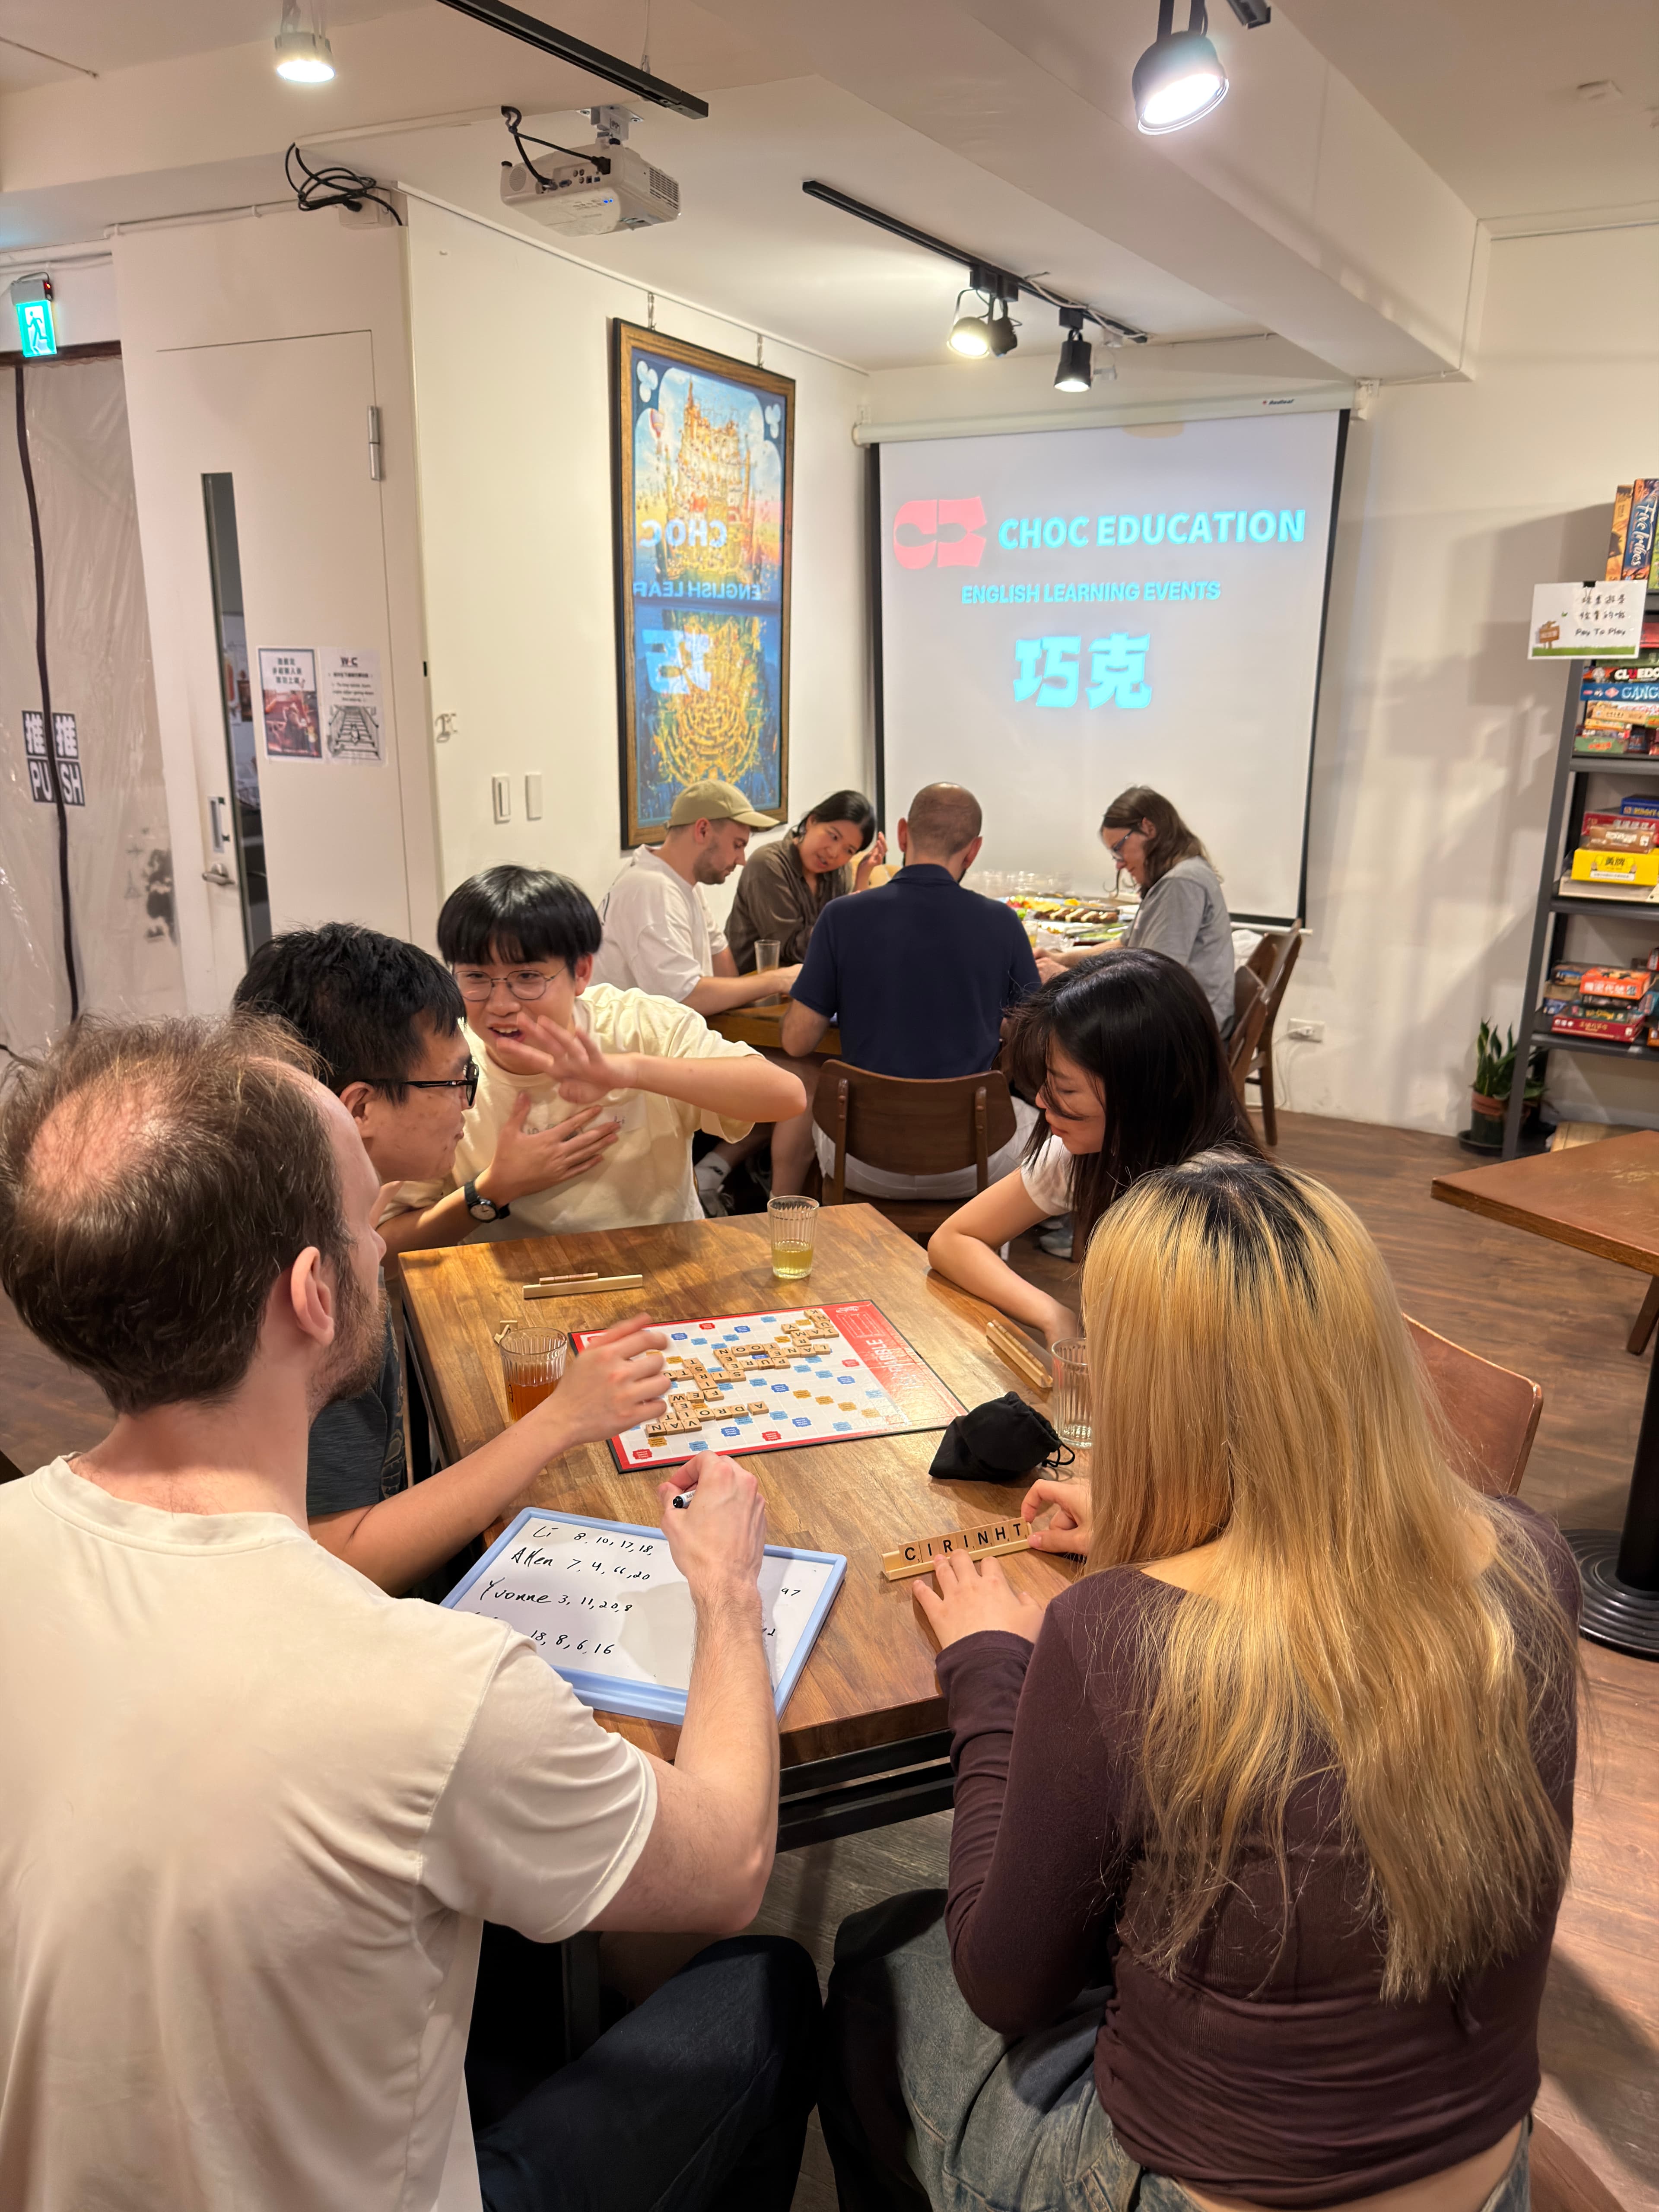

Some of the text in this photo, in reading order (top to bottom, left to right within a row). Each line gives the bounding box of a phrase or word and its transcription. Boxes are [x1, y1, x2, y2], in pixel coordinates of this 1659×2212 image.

[998, 510, 1305, 549] CHOC EDUCATION
[1636, 494, 1658, 530] Five
[1630, 522, 1653, 566] Tribes
[962, 581, 1220, 603] ENGLISH LEARNING EVENTS
[1014, 633, 1151, 709] 巧克
[1615, 667, 1659, 680] CLUEDO
[25, 713, 77, 756] 推 推
[904, 1523, 1021, 1560] CIRINHT
[480, 1577, 552, 1604] Yvonne
